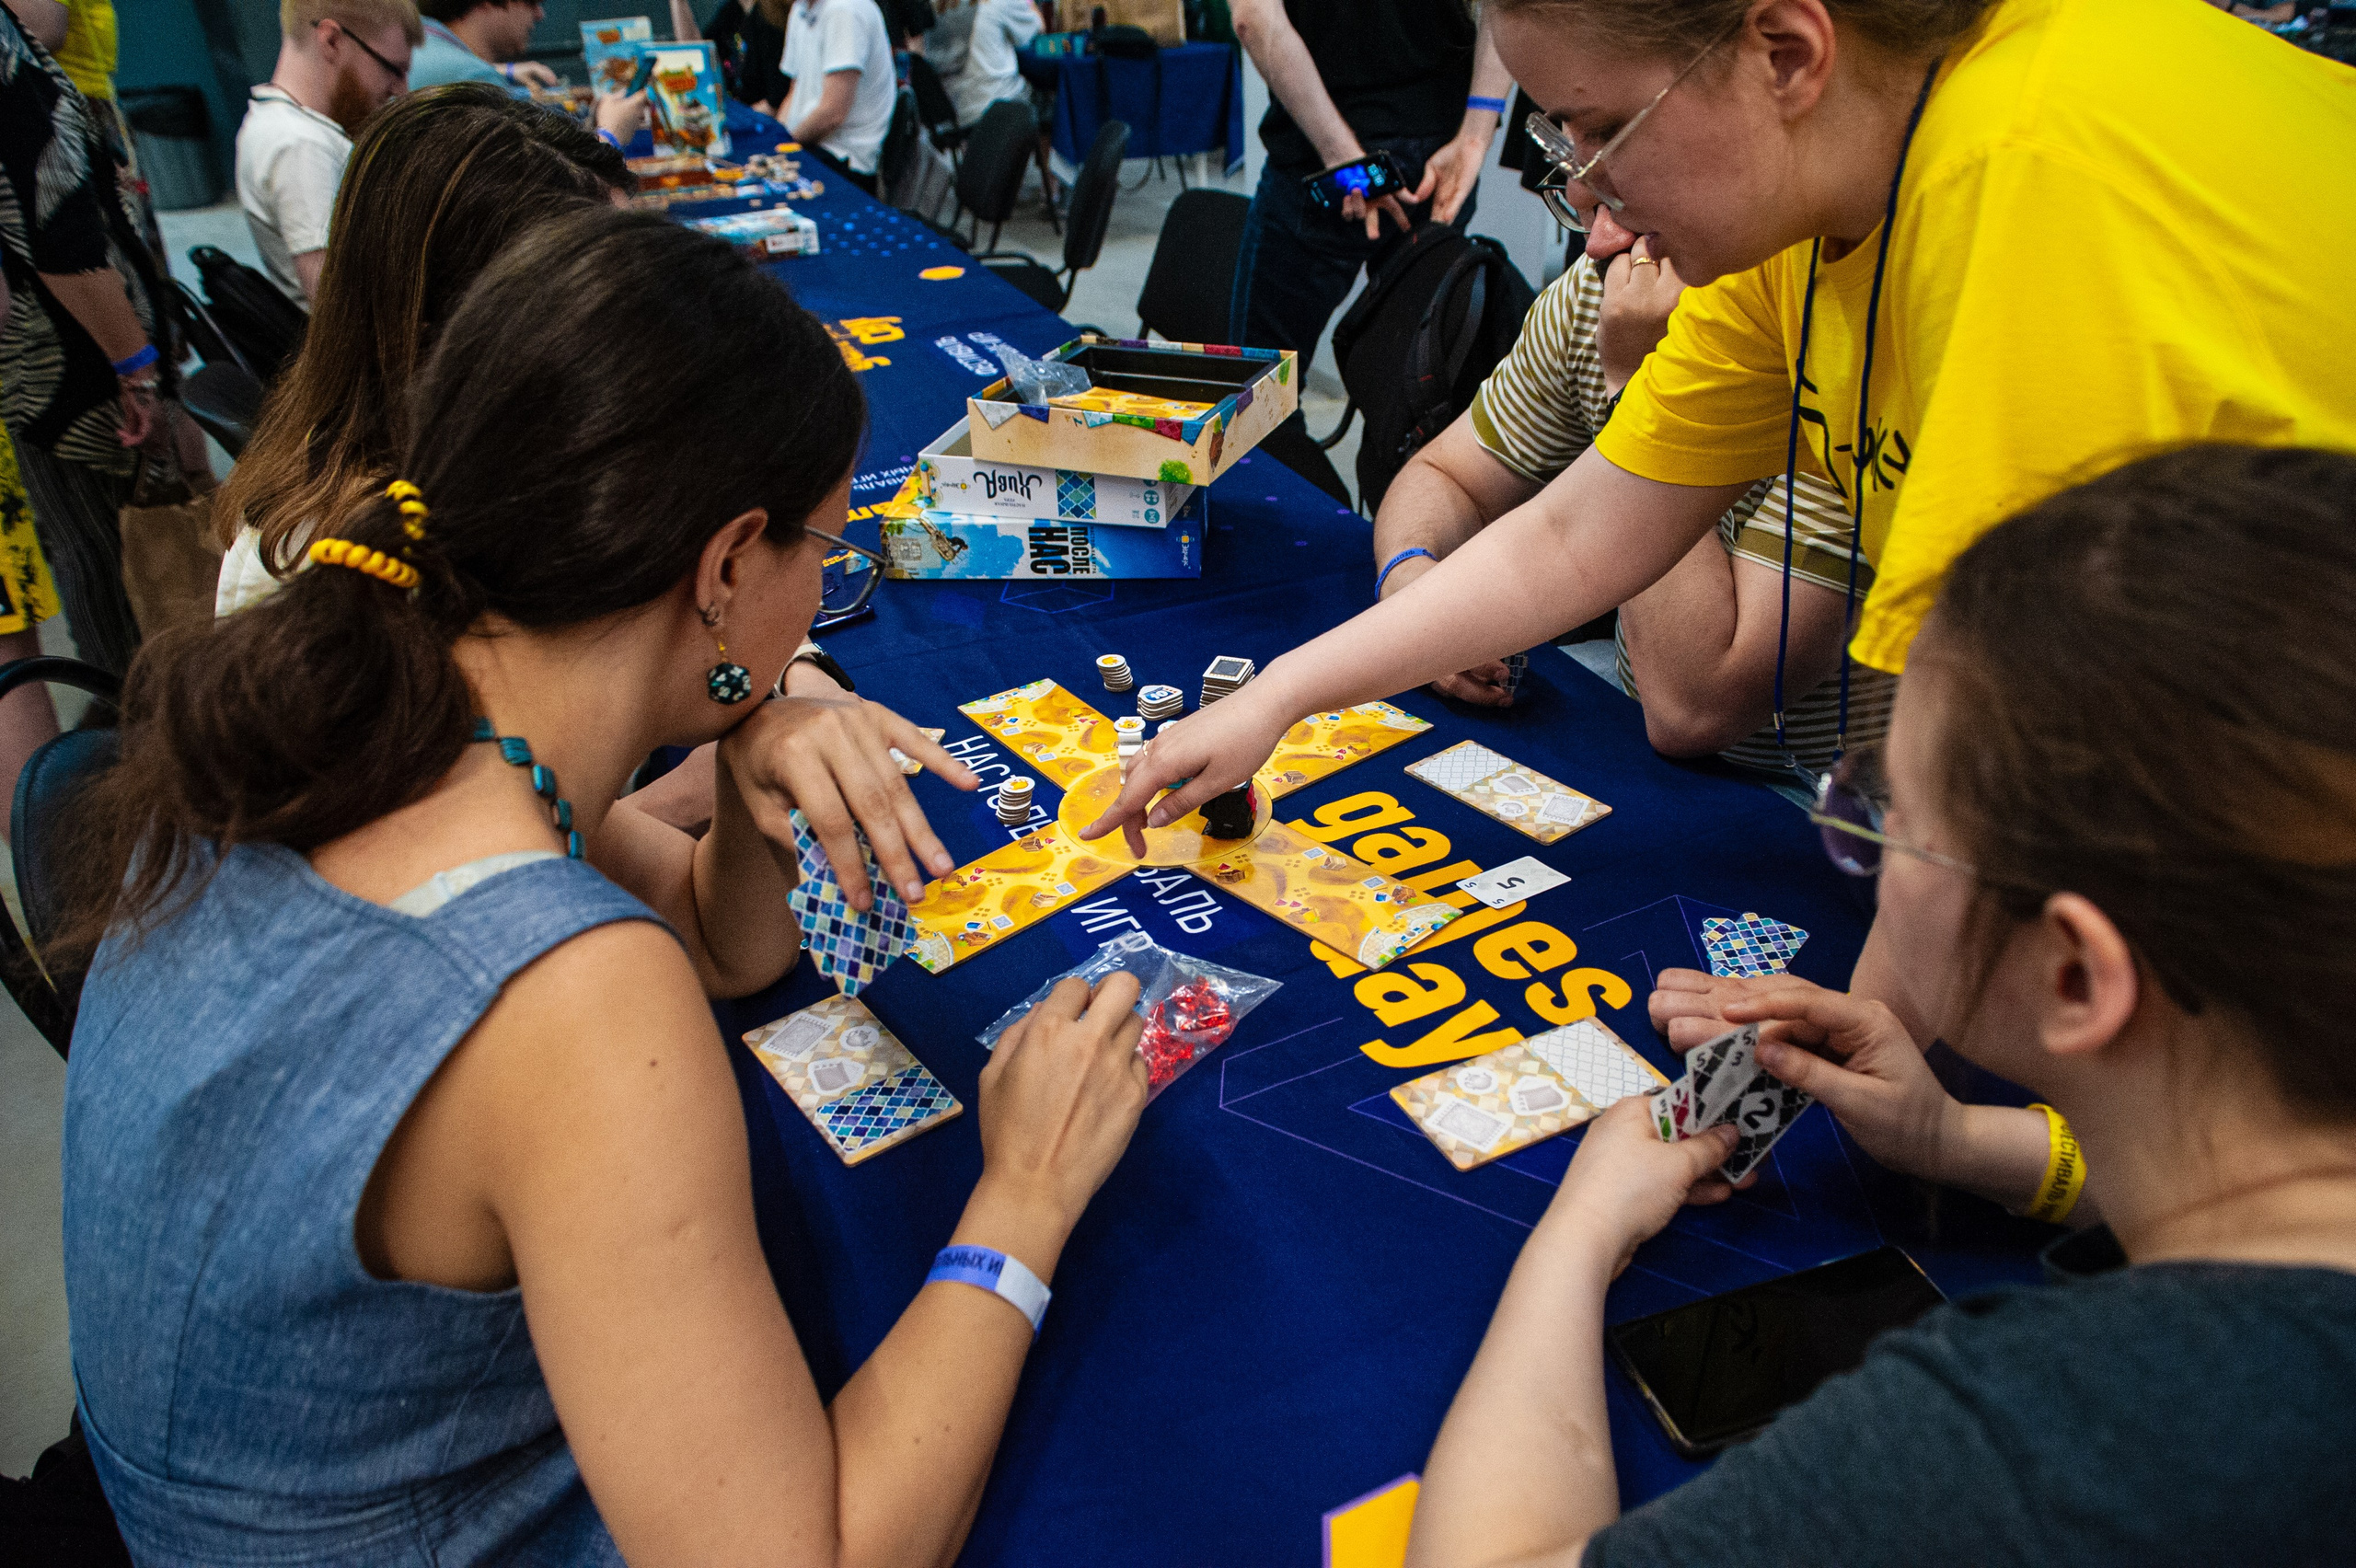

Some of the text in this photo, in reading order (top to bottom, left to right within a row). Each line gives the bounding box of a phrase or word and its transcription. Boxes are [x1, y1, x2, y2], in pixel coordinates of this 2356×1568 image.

[1028, 526, 1071, 575] НАС
[1070, 526, 1091, 575] ПОСЛЕ
[1496, 876, 1526, 890] 5
[1070, 896, 1151, 953] ИГР
[1743, 1097, 1776, 1130] 2
